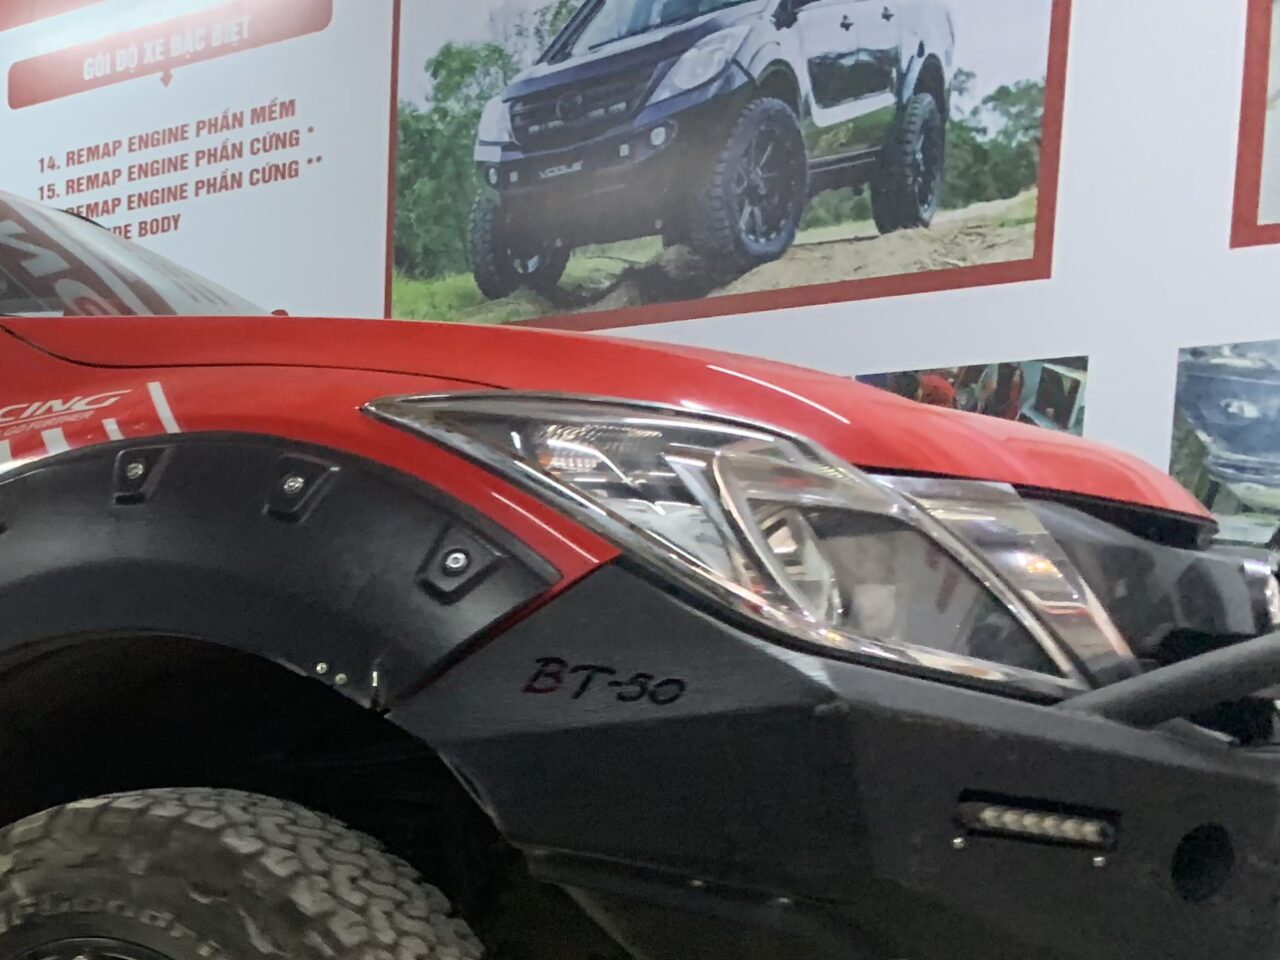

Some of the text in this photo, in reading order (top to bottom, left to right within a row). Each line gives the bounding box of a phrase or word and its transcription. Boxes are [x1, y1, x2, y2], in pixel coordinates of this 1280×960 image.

[143, 37, 165, 65] XE
[38, 155, 61, 173] 14.
[66, 139, 122, 167] REMAP
[128, 123, 189, 153] ENGINE
[38, 183, 60, 201] 15.
[65, 168, 122, 195] REMAP
[127, 153, 189, 182] ENGINE
[127, 183, 188, 211] ENGINE
[138, 213, 181, 238] BODY
